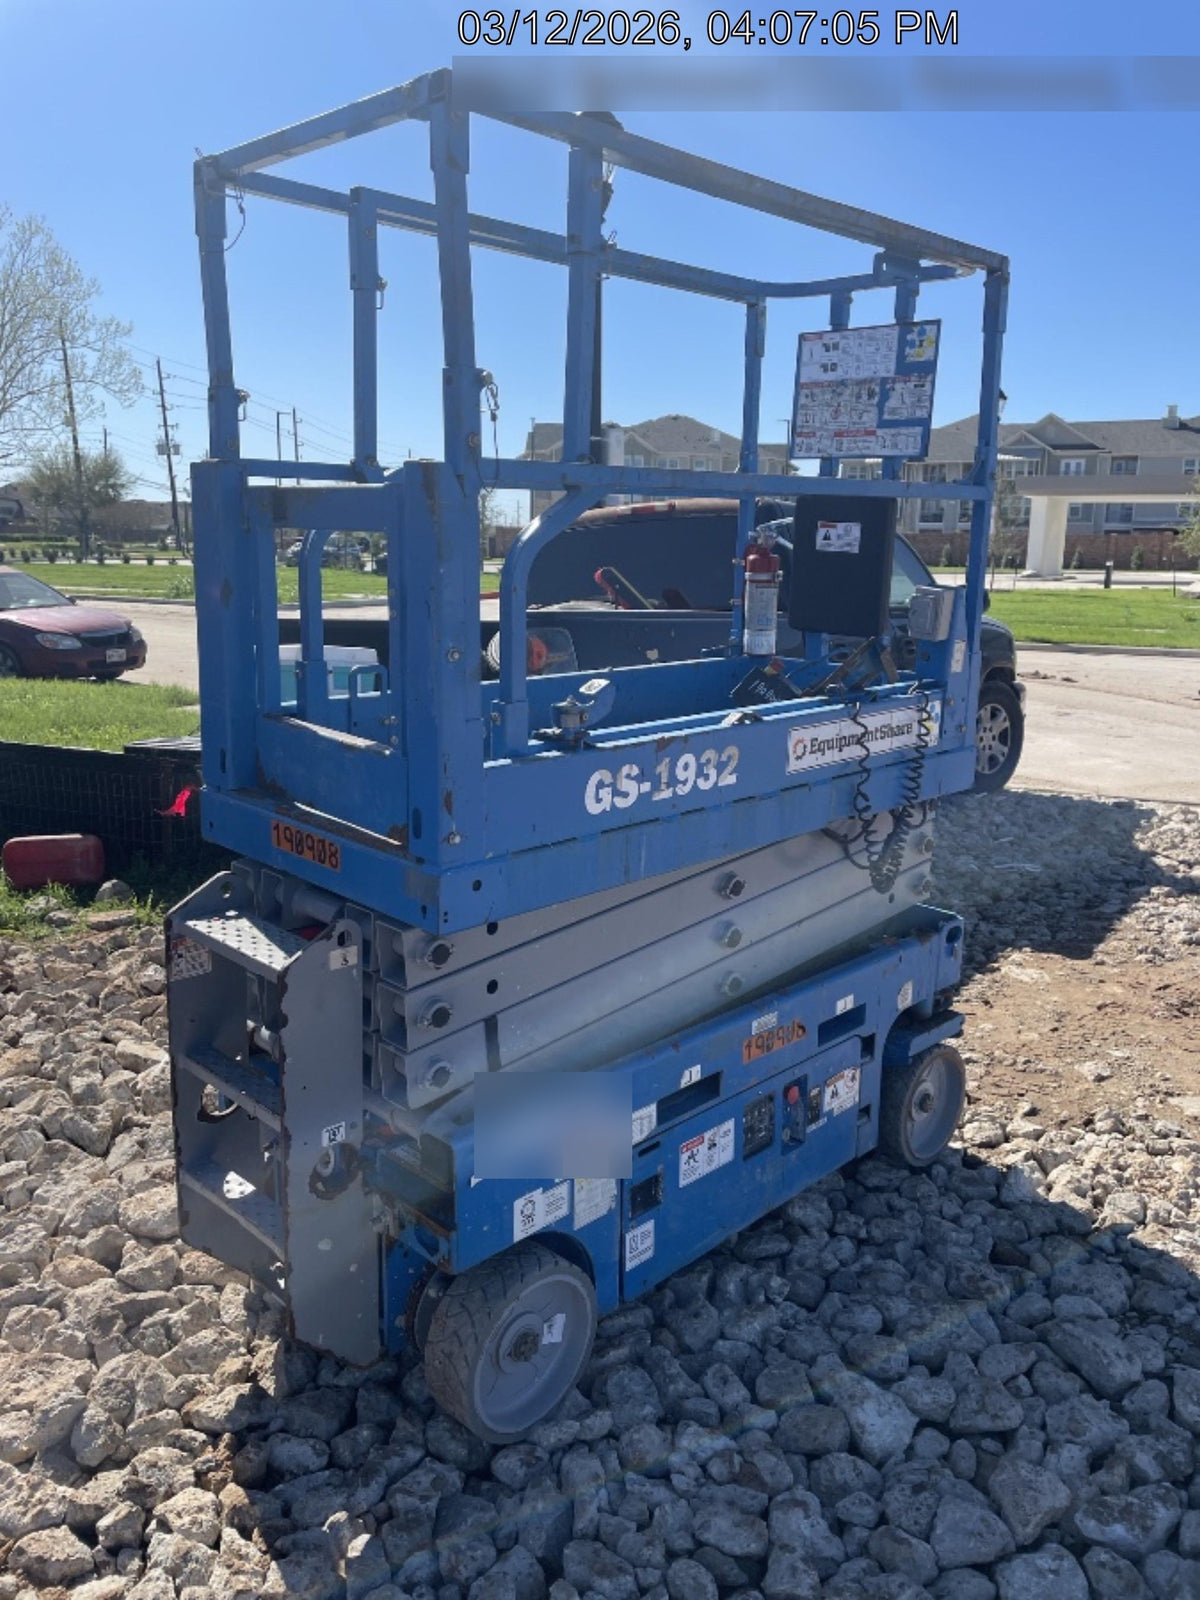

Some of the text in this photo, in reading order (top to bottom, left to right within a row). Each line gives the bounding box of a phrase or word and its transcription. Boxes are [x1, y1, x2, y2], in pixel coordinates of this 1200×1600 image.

[808, 722, 913, 756] EquipmntShare
[584, 745, 739, 815] GS-1932
[273, 821, 340, 870] 190908
